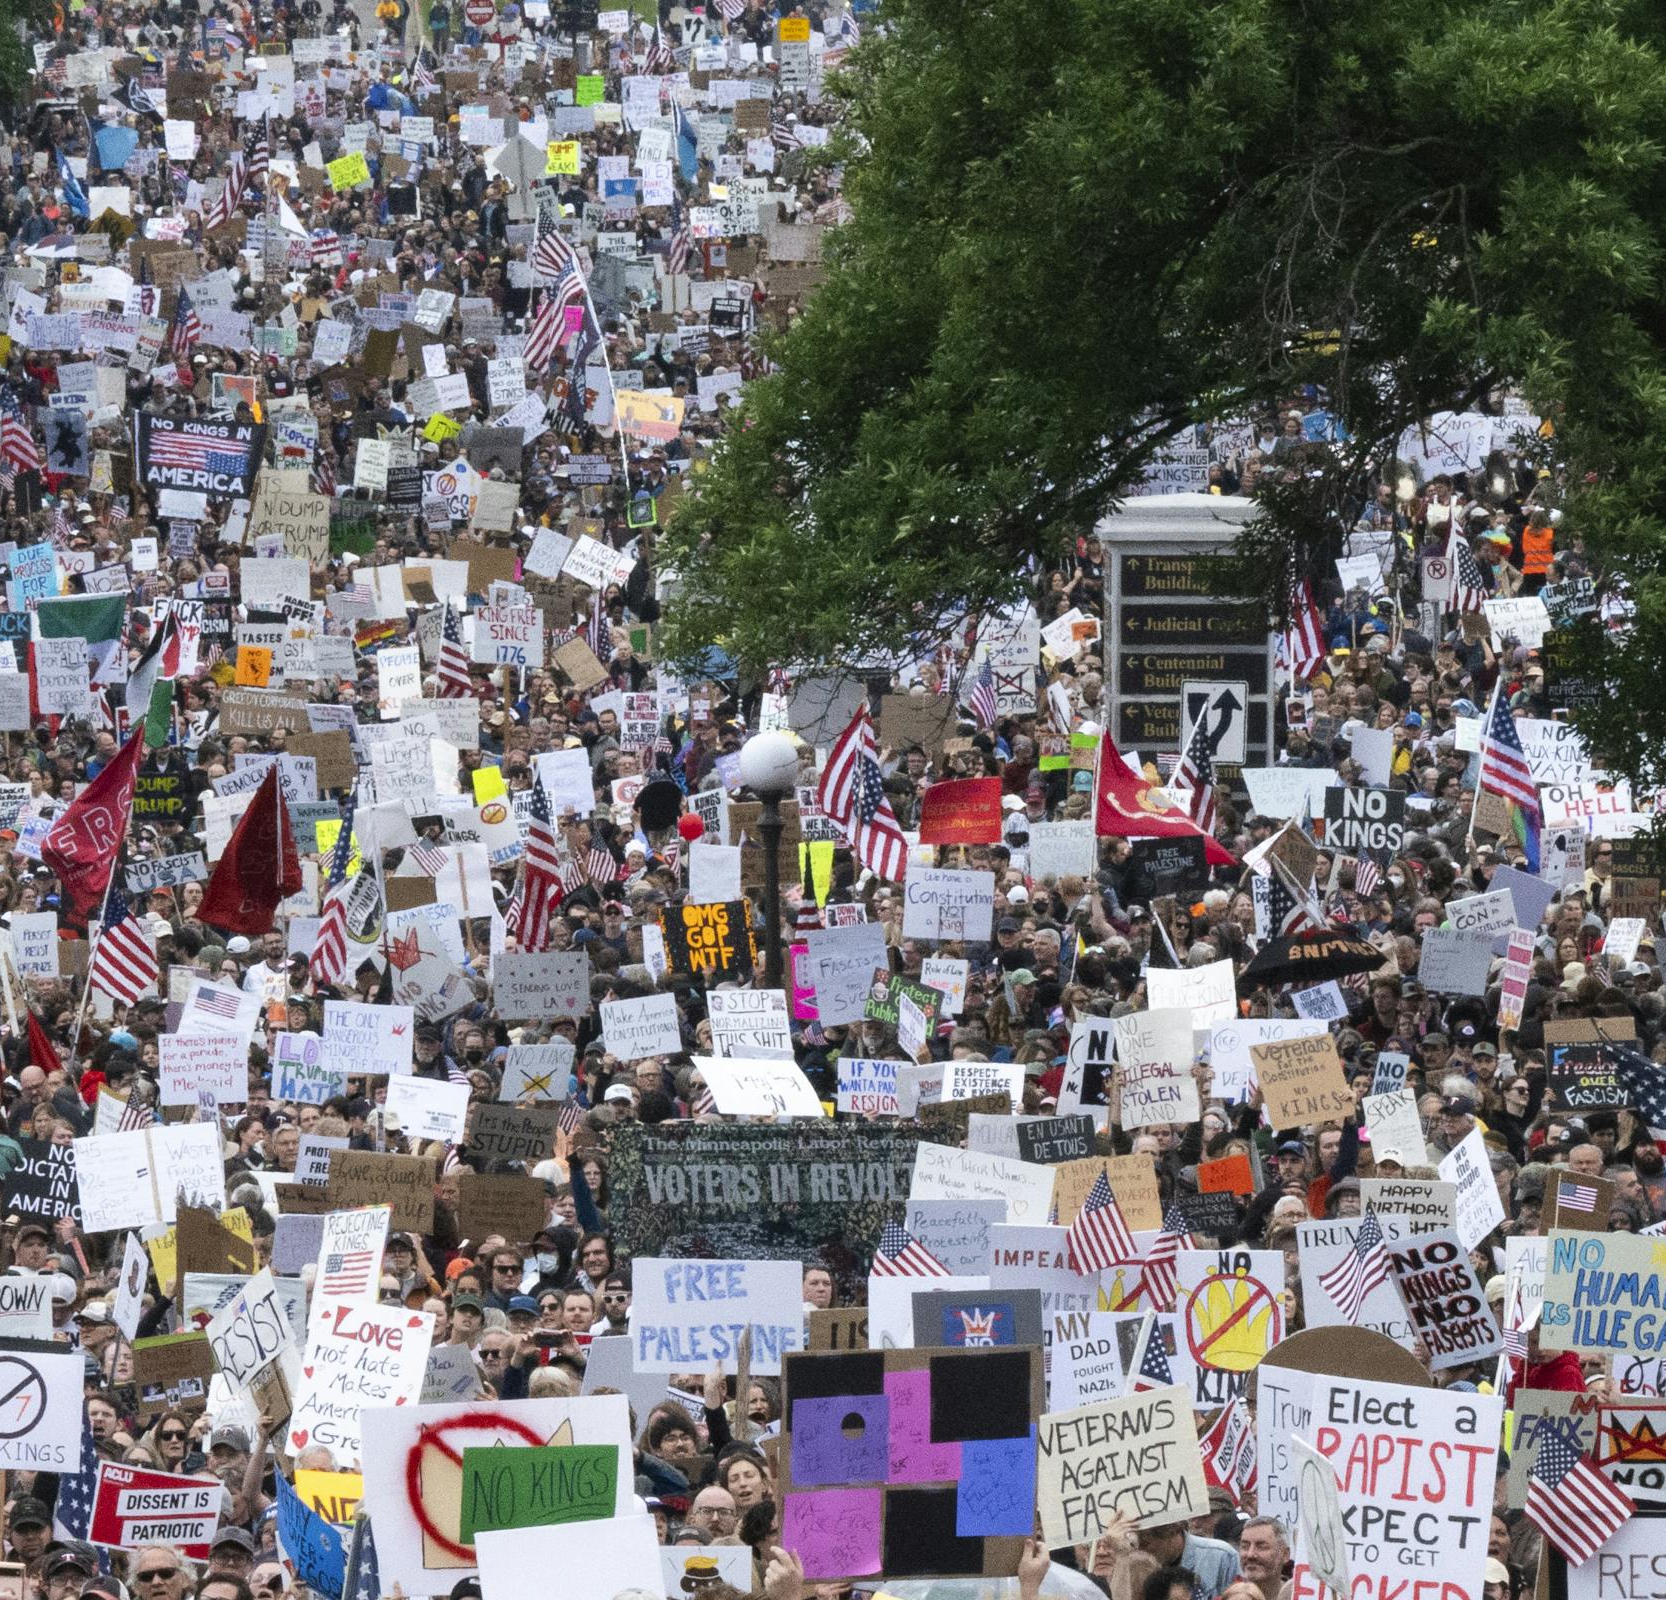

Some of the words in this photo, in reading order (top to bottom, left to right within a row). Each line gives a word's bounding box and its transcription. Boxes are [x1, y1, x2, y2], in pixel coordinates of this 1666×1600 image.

[151, 418, 174, 430] NO
[184, 421, 228, 436] KINGS
[237, 427, 252, 440] IN
[148, 468, 245, 493] AMERICA
[18, 547, 45, 562] DUE
[13, 558, 53, 579] PROCESS
[22, 577, 48, 594] FOR
[478, 607, 509, 623] KING
[510, 609, 537, 626] FREE
[1143, 616, 1201, 632] Judicial
[490, 625, 530, 642] SINCE
[496, 645, 527, 664] 1776
[1143, 654, 1225, 670] Centennial
[1343, 792, 1385, 819] NO
[1325, 819, 1403, 852] KINGS
[683, 904, 727, 926] OMG
[687, 925, 729, 948] GOP
[689, 948, 734, 971] WTF
[647, 1138, 677, 1150] The
[686, 1135, 791, 1152] Minneapolis
[799, 1137, 849, 1149] Labor
[855, 1137, 917, 1149] Review
[644, 1164, 760, 1203] VOTERS
[769, 1163, 800, 1202] IN
[1554, 1238, 1605, 1274] NO
[664, 1262, 748, 1303] FREE
[1543, 1302, 1569, 1328] IS
[211, 1290, 285, 1394] RESIST
[333, 1306, 403, 1352] Love
[314, 1344, 347, 1365] not
[354, 1347, 401, 1378] hate
[330, 1373, 391, 1400] Makes
[1328, 1386, 1418, 1429] Elect
[1455, 1406, 1477, 1434] a
[1039, 1400, 1175, 1456] VETERANS
[1061, 1442, 1177, 1491] AGAINST
[1317, 1428, 1495, 1506] RAPIST
[125, 1490, 189, 1511] DISSENT
[193, 1491, 210, 1509] IS
[471, 1466, 515, 1526] NO
[530, 1455, 610, 1509] KINGS
[1062, 1478, 1192, 1532] FASCISM
[130, 1522, 204, 1541] PATRIOTIC
[1341, 1504, 1483, 1548] XPECT
[1352, 1542, 1379, 1562] TO
[1398, 1546, 1441, 1568] GET
